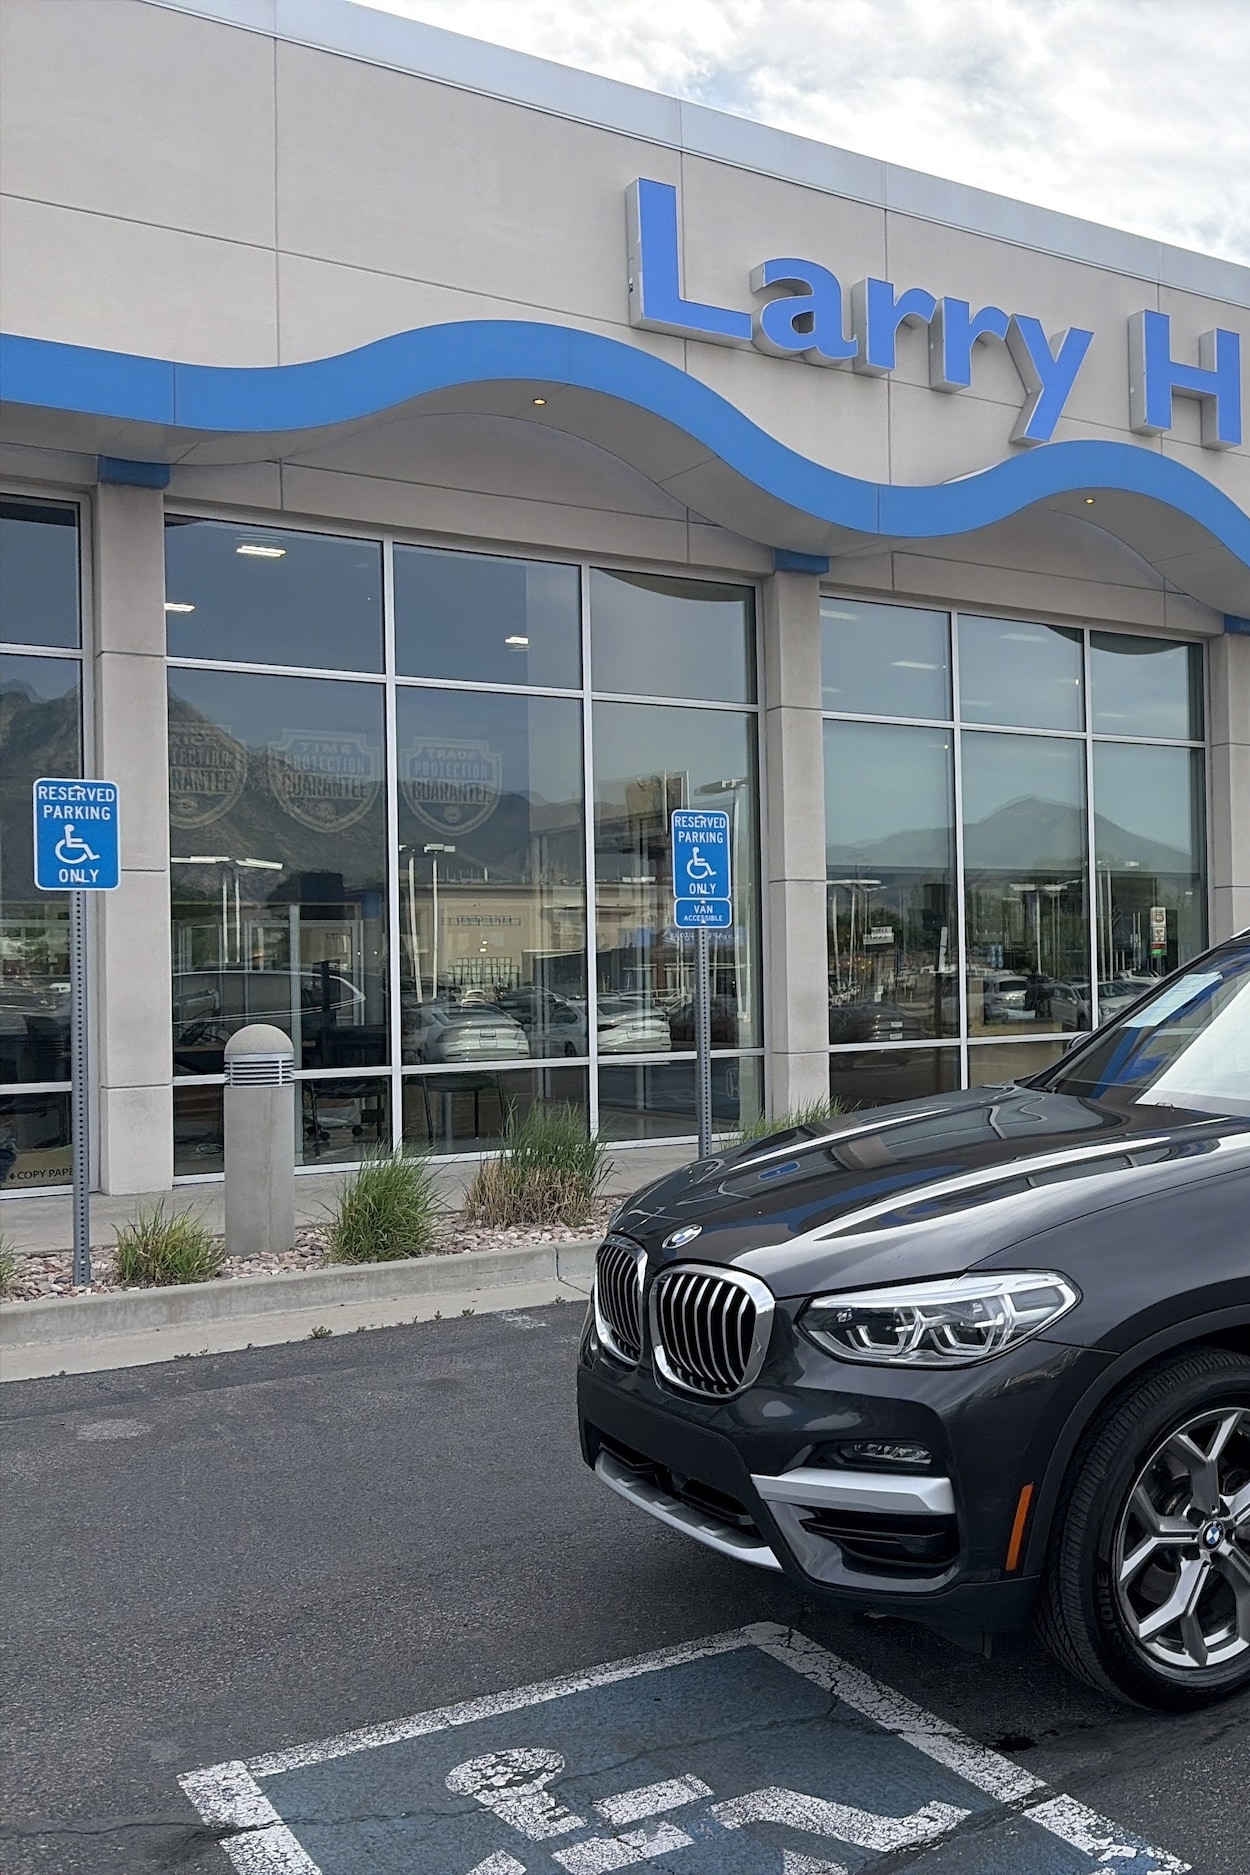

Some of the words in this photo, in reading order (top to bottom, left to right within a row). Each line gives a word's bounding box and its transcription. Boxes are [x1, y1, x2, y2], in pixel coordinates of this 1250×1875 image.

[630, 177, 1095, 444] Larry
[1138, 309, 1242, 448] H
[38, 785, 115, 803] RESERVED
[43, 804, 111, 821] PARKING
[674, 815, 726, 829] RESERVED
[678, 831, 724, 844] PARKING
[58, 868, 100, 884] ONLY
[689, 882, 716, 895] ONLY
[693, 904, 713, 914] VAN
[683, 914, 723, 922] ACCESSIBLE
[17, 1169, 46, 1180] COPY
[48, 1167, 73, 1178] PAPE
